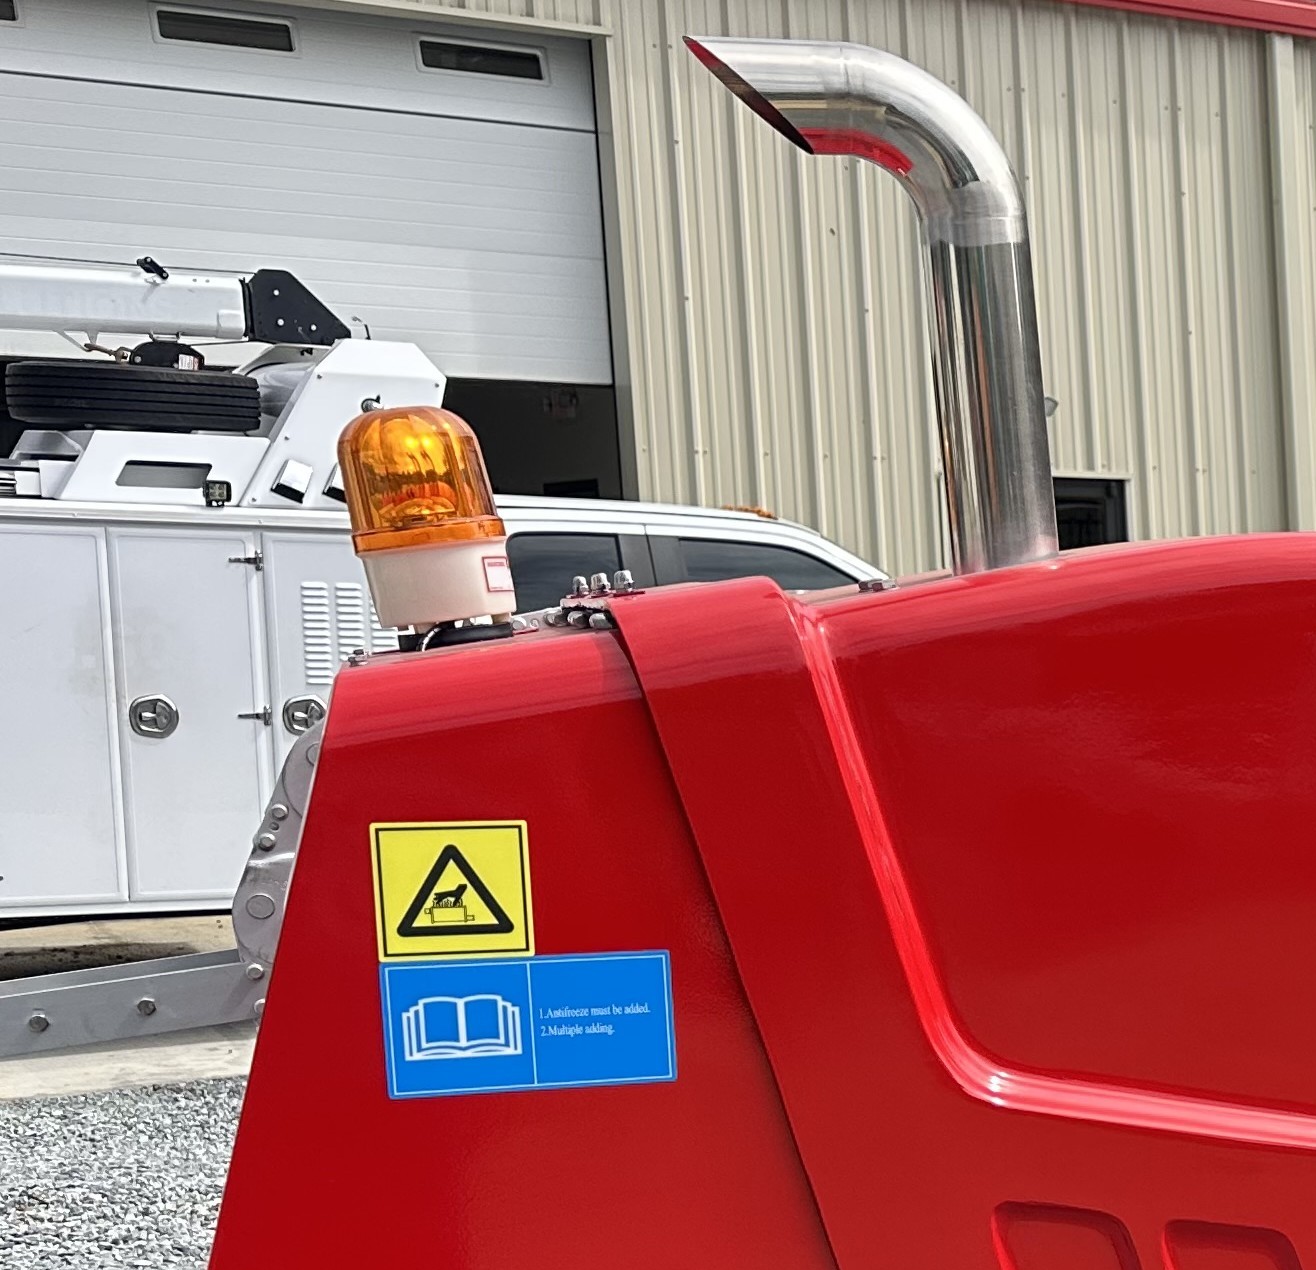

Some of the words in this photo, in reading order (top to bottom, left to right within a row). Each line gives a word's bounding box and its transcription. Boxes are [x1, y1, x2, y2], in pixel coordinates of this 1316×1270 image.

[539, 1006, 589, 1019] 1.Antifreeze
[590, 1006, 611, 1017] must
[612, 1003, 623, 1015] be
[623, 1002, 651, 1015] added.
[540, 1023, 584, 1038] 2.Multiple
[584, 1022, 615, 1036] adding.
